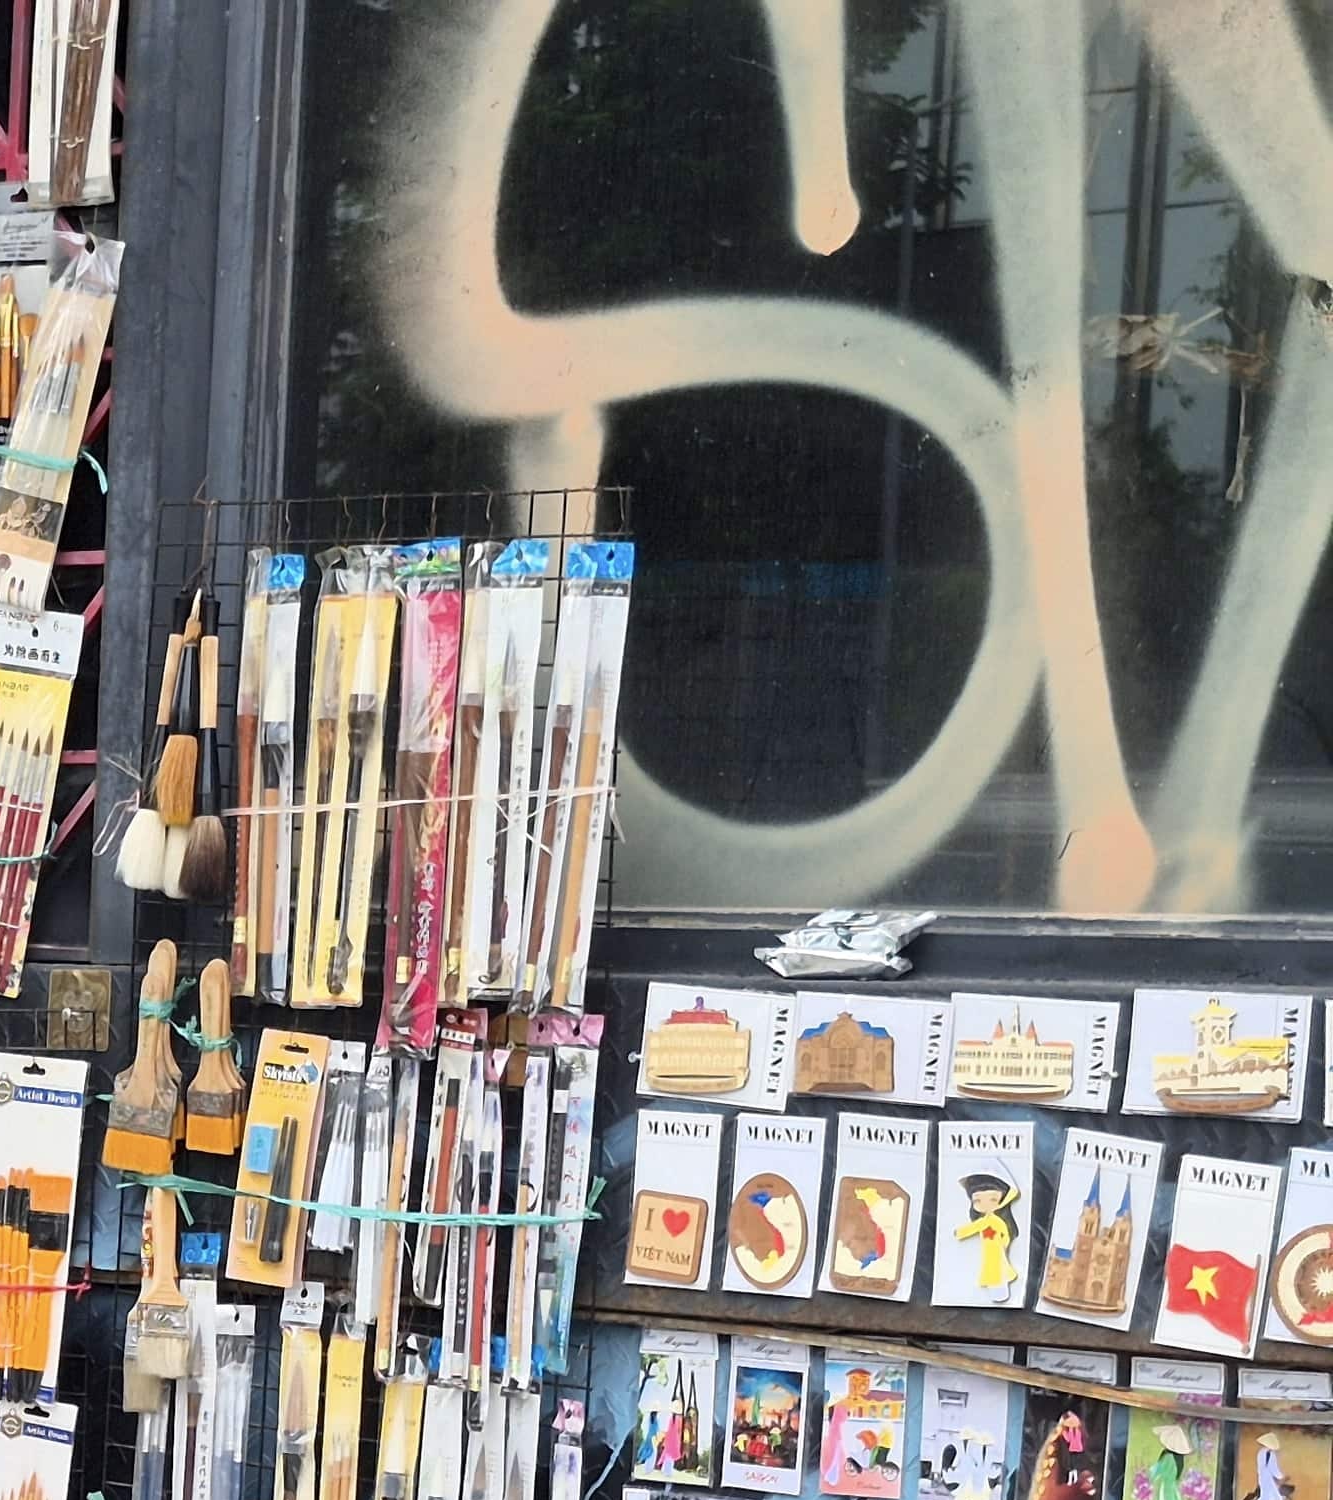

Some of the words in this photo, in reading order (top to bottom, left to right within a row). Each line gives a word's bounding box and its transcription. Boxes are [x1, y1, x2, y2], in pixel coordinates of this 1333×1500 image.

[765, 1006, 789, 1095] MAGNET
[921, 1013, 945, 1095] MAGNET
[1086, 1013, 1108, 1097] MAGNET
[15, 1088, 44, 1102] Artist
[47, 1090, 78, 1105] Brush
[645, 1119, 714, 1140] MAGNET
[746, 1125, 815, 1144] MAGNET
[848, 1124, 920, 1147] MAGNET
[949, 1133, 1024, 1151] MAGNET
[1073, 1141, 1153, 1170] MAGNET
[1188, 1166, 1271, 1193] MAGNET
[644, 1207, 654, 1231] I
[664, 1248, 692, 1266] NAM
